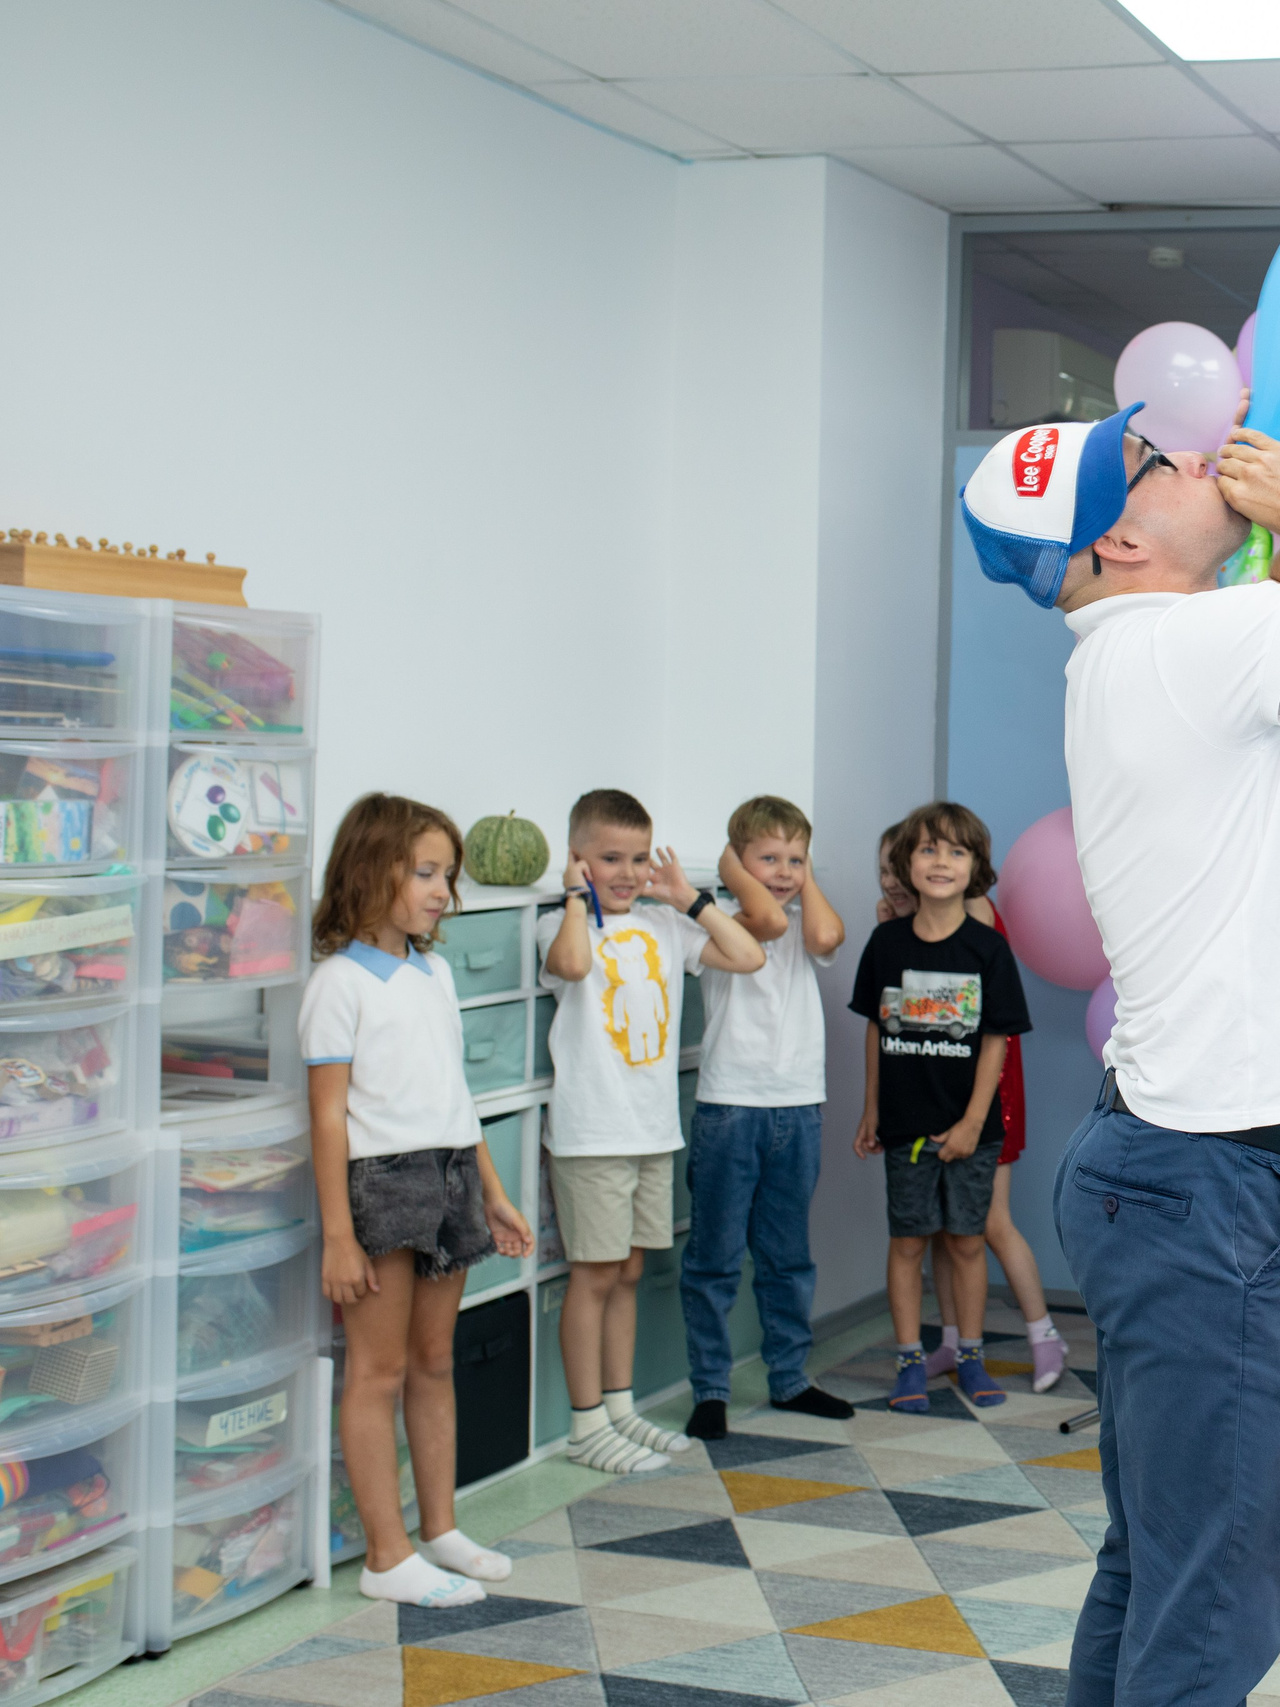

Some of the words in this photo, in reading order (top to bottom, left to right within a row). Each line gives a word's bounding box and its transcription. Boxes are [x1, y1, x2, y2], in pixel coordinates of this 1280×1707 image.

[1017, 466, 1040, 492] Lee
[881, 1036, 921, 1055] Urban
[921, 1040, 972, 1058] Artists
